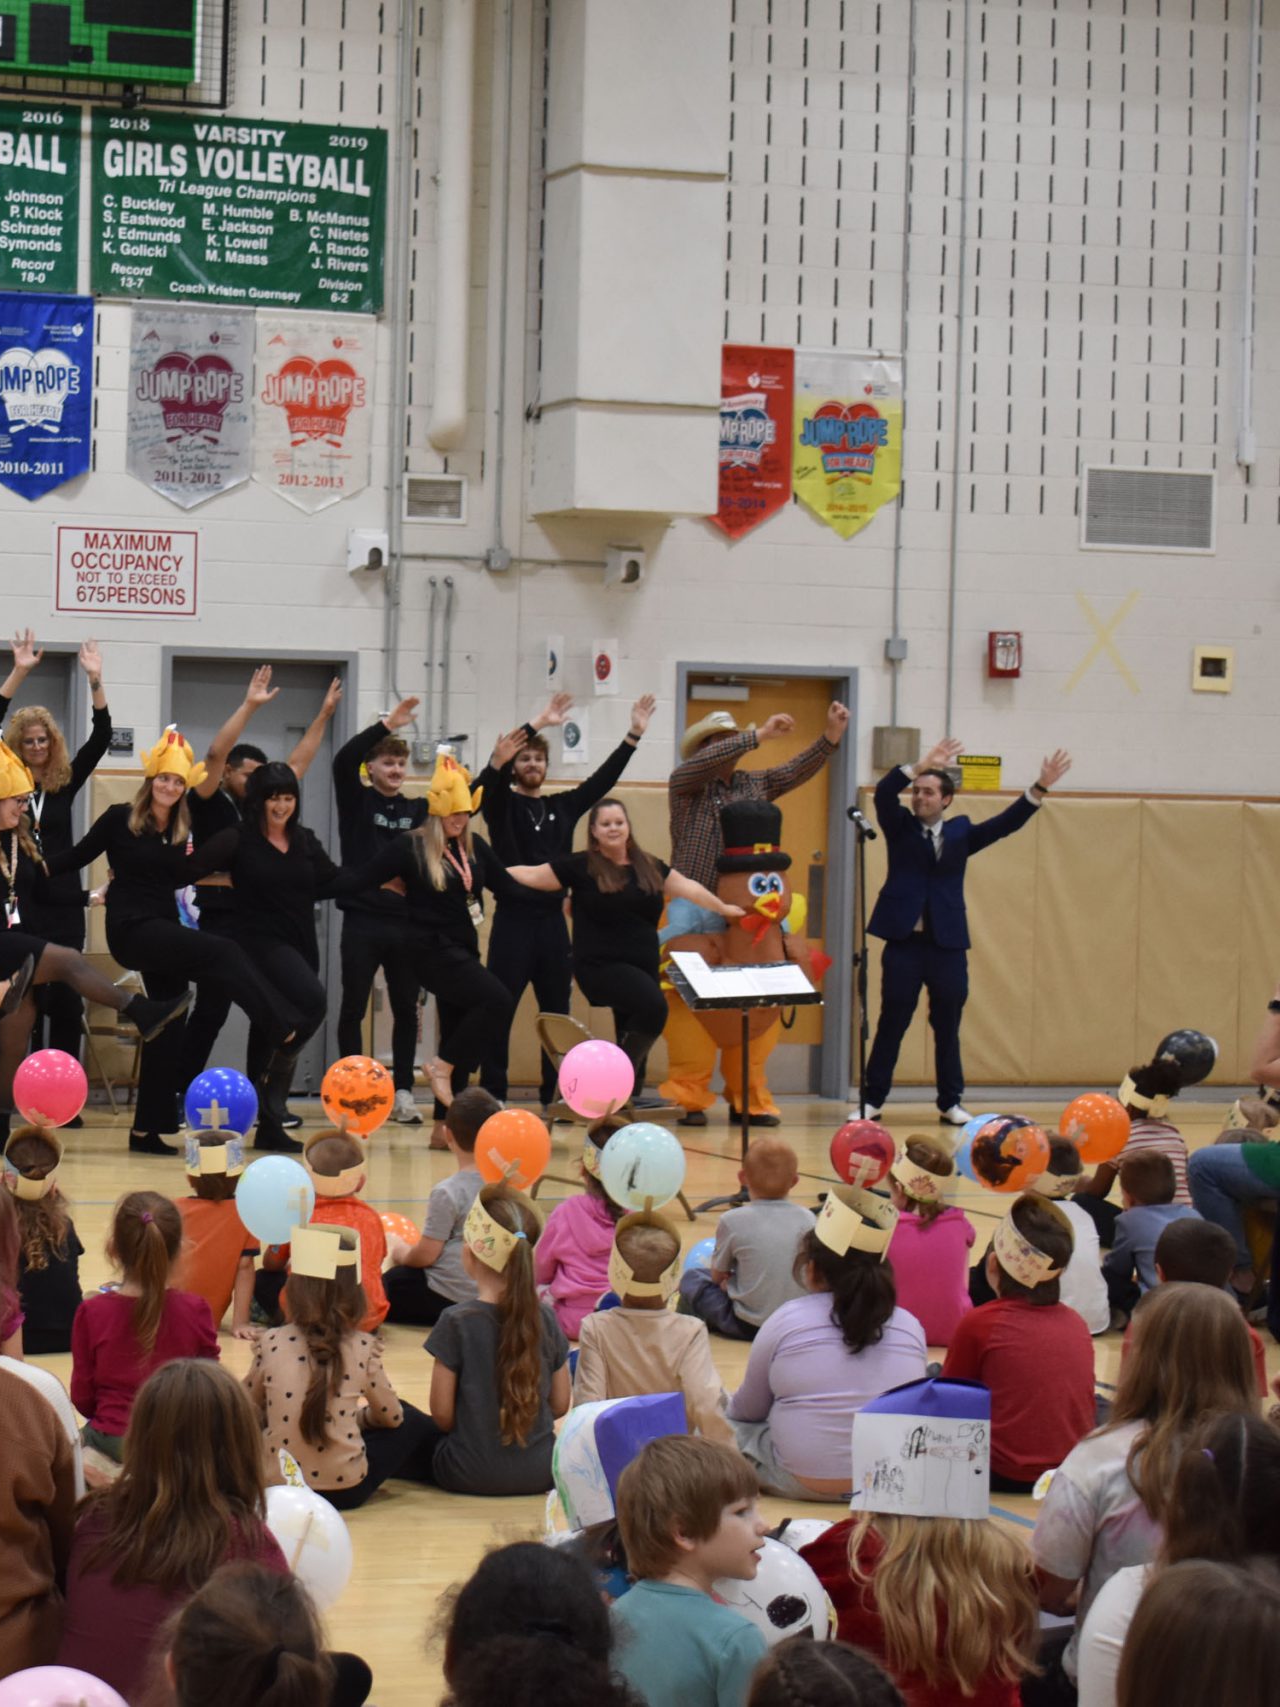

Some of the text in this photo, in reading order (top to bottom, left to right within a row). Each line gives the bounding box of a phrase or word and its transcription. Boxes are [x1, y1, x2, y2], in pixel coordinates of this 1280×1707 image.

[23, 112, 63, 124] 2016
[110, 118, 150, 131] 2018
[194, 125, 285, 147] VARSITY
[329, 136, 368, 150] 2019
[104, 140, 370, 197] GIRLS VOLLEYBALL
[5, 189, 63, 204] Johnson
[159, 179, 319, 204] Tri League Champions
[10, 205, 62, 220] P. Klock
[103, 194, 175, 216] C. Buckley
[203, 203, 273, 220] M. Humble
[103, 210, 185, 228] S. Eastwood
[202, 218, 273, 234] E. Jackson
[290, 209, 369, 227] B. McManus
[1, 220, 62, 236] Schrader
[103, 226, 181, 243] J. Edmunds
[310, 226, 369, 242] C. Nietes
[0, 236, 62, 252] Symonds
[103, 241, 167, 257] K. Golicki
[207, 234, 267, 249] K. Lowell
[308, 241, 369, 257] A. Rando
[12, 258, 55, 271] Record
[206, 249, 268, 265] M. Maass
[312, 257, 368, 272] J. Rivers
[21, 272, 45, 283] 18-0
[111, 263, 153, 276] Record
[121, 276, 144, 288] 13-7
[319, 278, 362, 291] Division
[170, 281, 301, 302] Coach Kristen Guernsey
[331, 292, 348, 303] 6-2
[34, 364, 81, 396] ROPE
[135, 369, 245, 404] JUMP ROPE
[261, 373, 367, 408] JUMP ROPE
[30, 404, 61, 419] HEART
[187, 412, 221, 430] HEART
[740, 418, 776, 444] ROPE
[799, 415, 888, 449] JUMP ROPE
[153, 470, 221, 485] 2011-2012
[278, 473, 344, 489] 2012-2013
[84, 532, 172, 552] MAXIMUM
[71, 552, 183, 572] OCCUPANCY
[76, 572, 177, 586] NOT TO EXCEED
[959, 756, 1000, 765] WARNING
